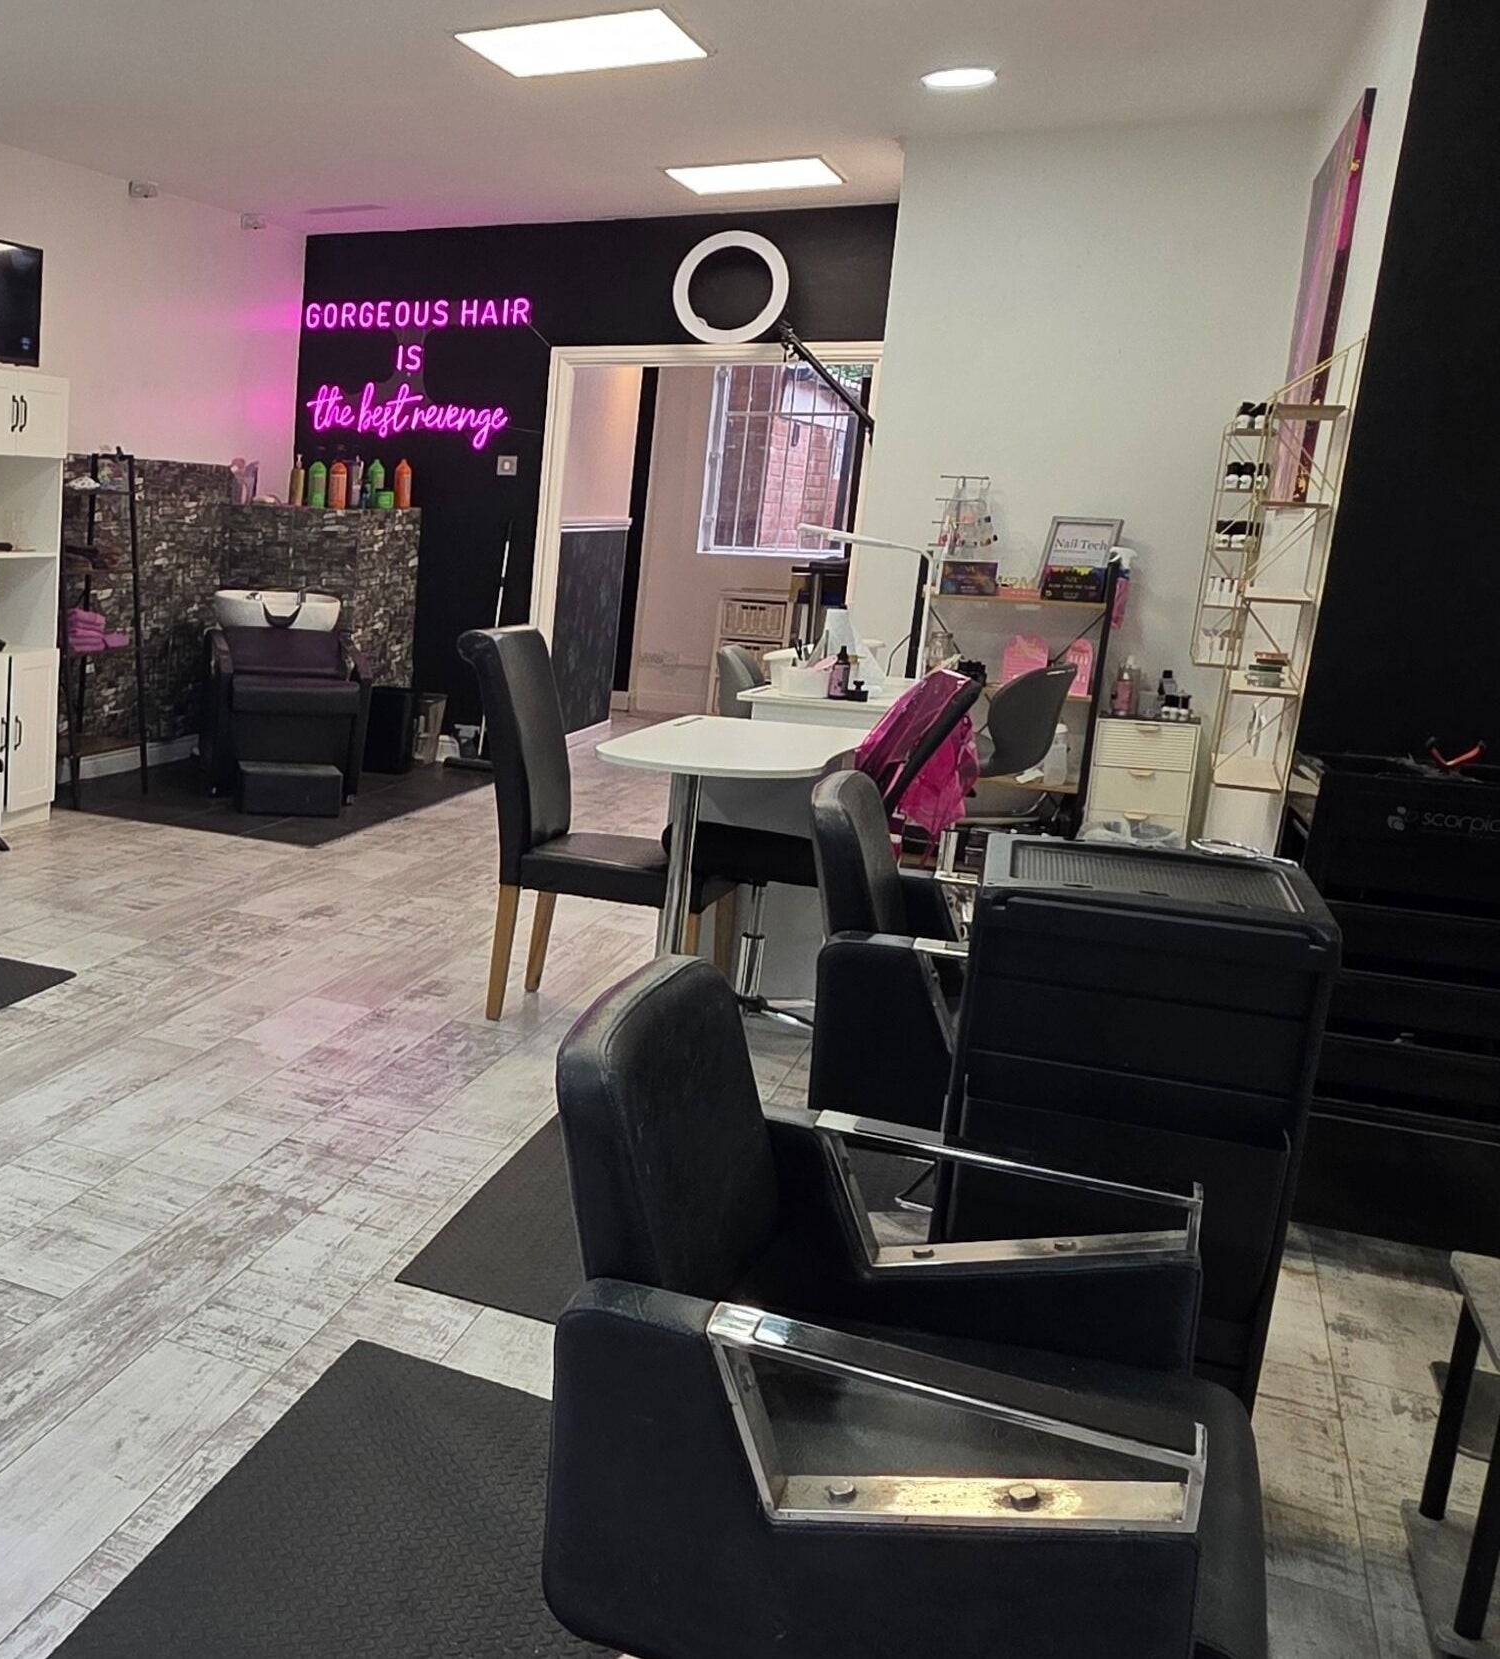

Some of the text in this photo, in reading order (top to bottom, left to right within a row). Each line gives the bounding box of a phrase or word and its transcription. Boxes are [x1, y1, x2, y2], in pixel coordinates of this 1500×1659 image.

[305, 298, 531, 329] GORGEOUS HAIR
[396, 344, 422, 371] IS
[306, 382, 509, 450] the best revenge
[1053, 537, 1109, 552] Nail Tech
